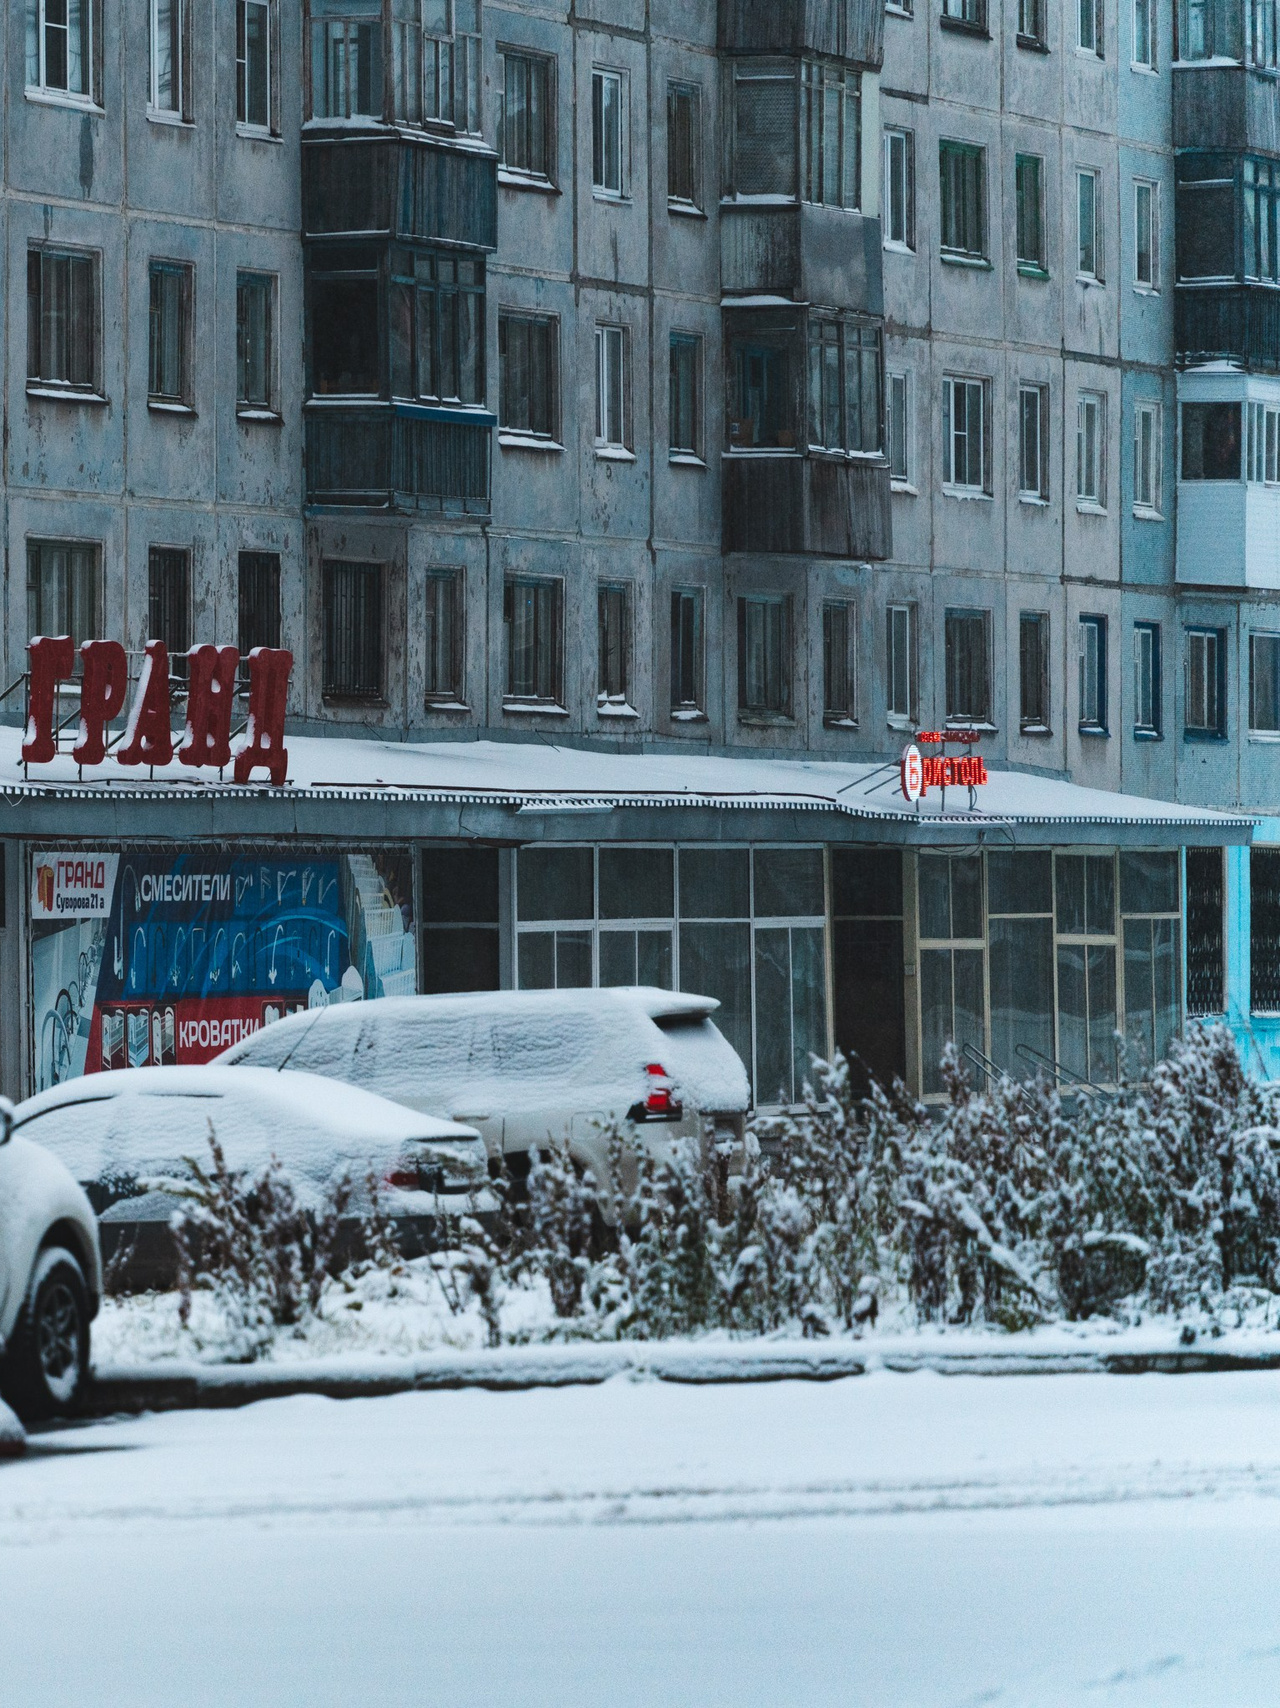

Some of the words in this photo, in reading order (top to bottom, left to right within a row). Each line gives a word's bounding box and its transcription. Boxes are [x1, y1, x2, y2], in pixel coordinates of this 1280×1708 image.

[22, 635, 293, 786] ГРАНД
[56, 861, 105, 888] ГРАНД
[141, 874, 231, 902] СМЕСИТЕЛИ
[56, 893, 90, 913] Суворова
[90, 893, 98, 909] 21
